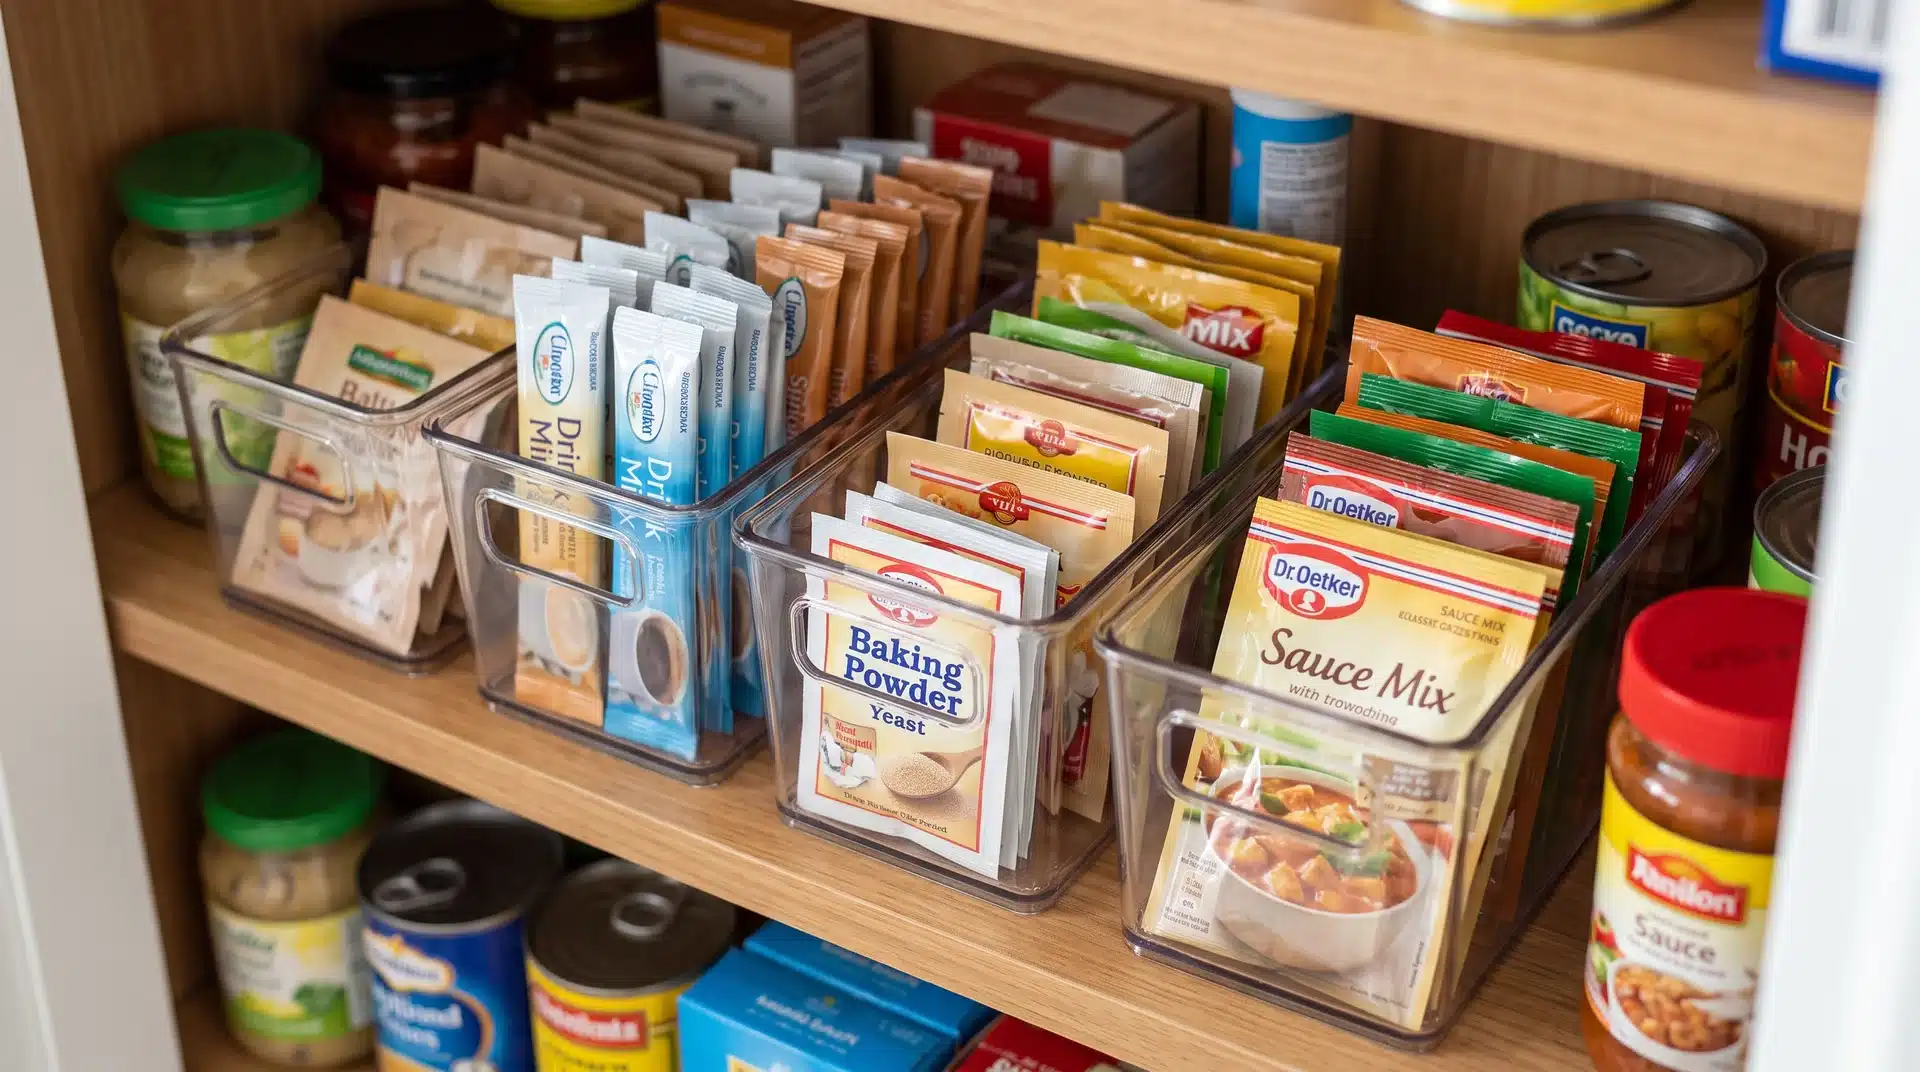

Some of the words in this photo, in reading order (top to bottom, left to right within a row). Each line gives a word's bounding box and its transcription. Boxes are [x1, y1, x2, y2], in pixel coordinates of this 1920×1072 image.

[1332, 496, 1396, 527] Oetker
[1273, 558, 1296, 581] Dr.
[1296, 565, 1360, 598] Oetker
[1440, 605, 1480, 626] SAUCE
[848, 625, 964, 692] Baking
[1260, 627, 1374, 692] Sauce
[1376, 662, 1457, 715] Mix
[843, 653, 963, 716] Powder
[1288, 682, 1320, 702] with
[869, 703, 926, 736] Yeast
[1634, 913, 1717, 964] Sauce
